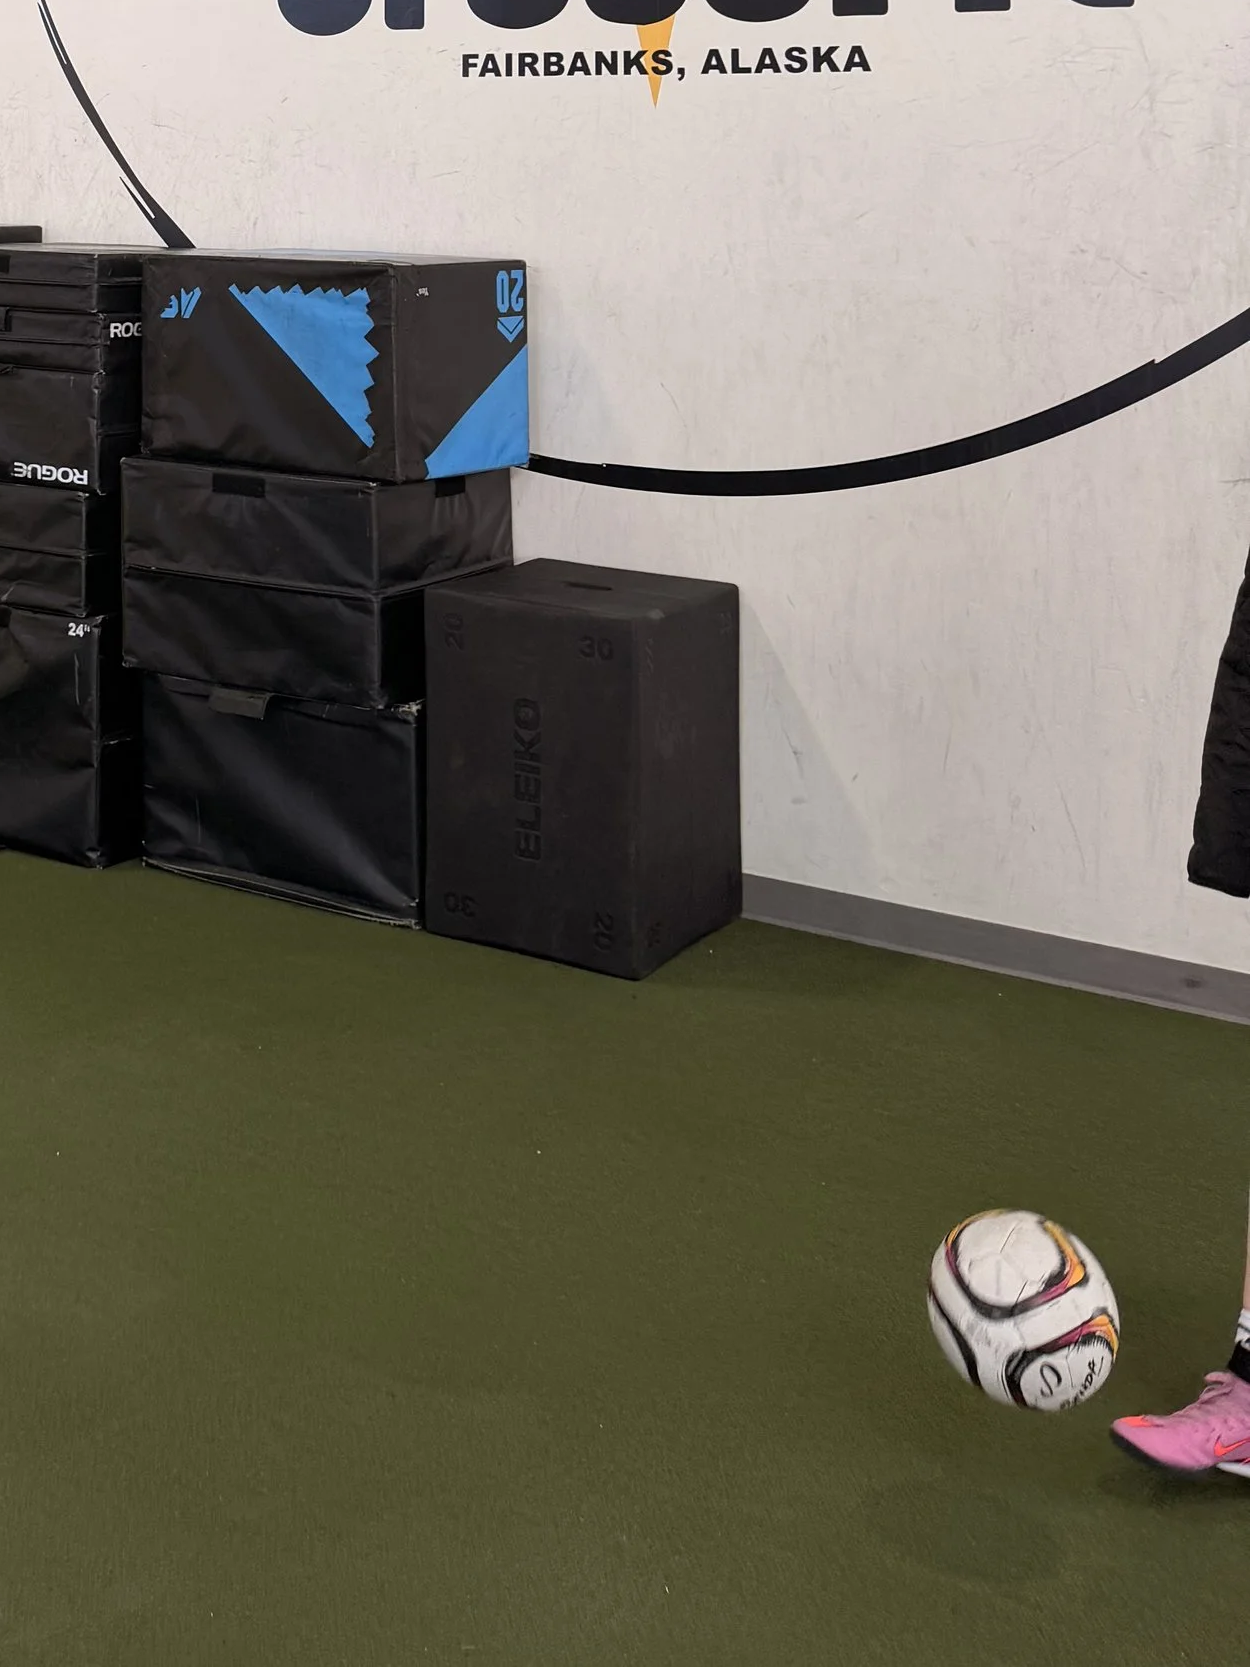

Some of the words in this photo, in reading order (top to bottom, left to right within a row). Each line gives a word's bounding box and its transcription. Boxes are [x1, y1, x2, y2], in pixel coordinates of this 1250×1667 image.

[461, 50, 686, 81] FAIRBANKS,
[701, 45, 872, 75] ALASKA
[12, 461, 89, 485] ROGUE
[578, 635, 615, 661] 30
[514, 697, 542, 862] ELEIKO
